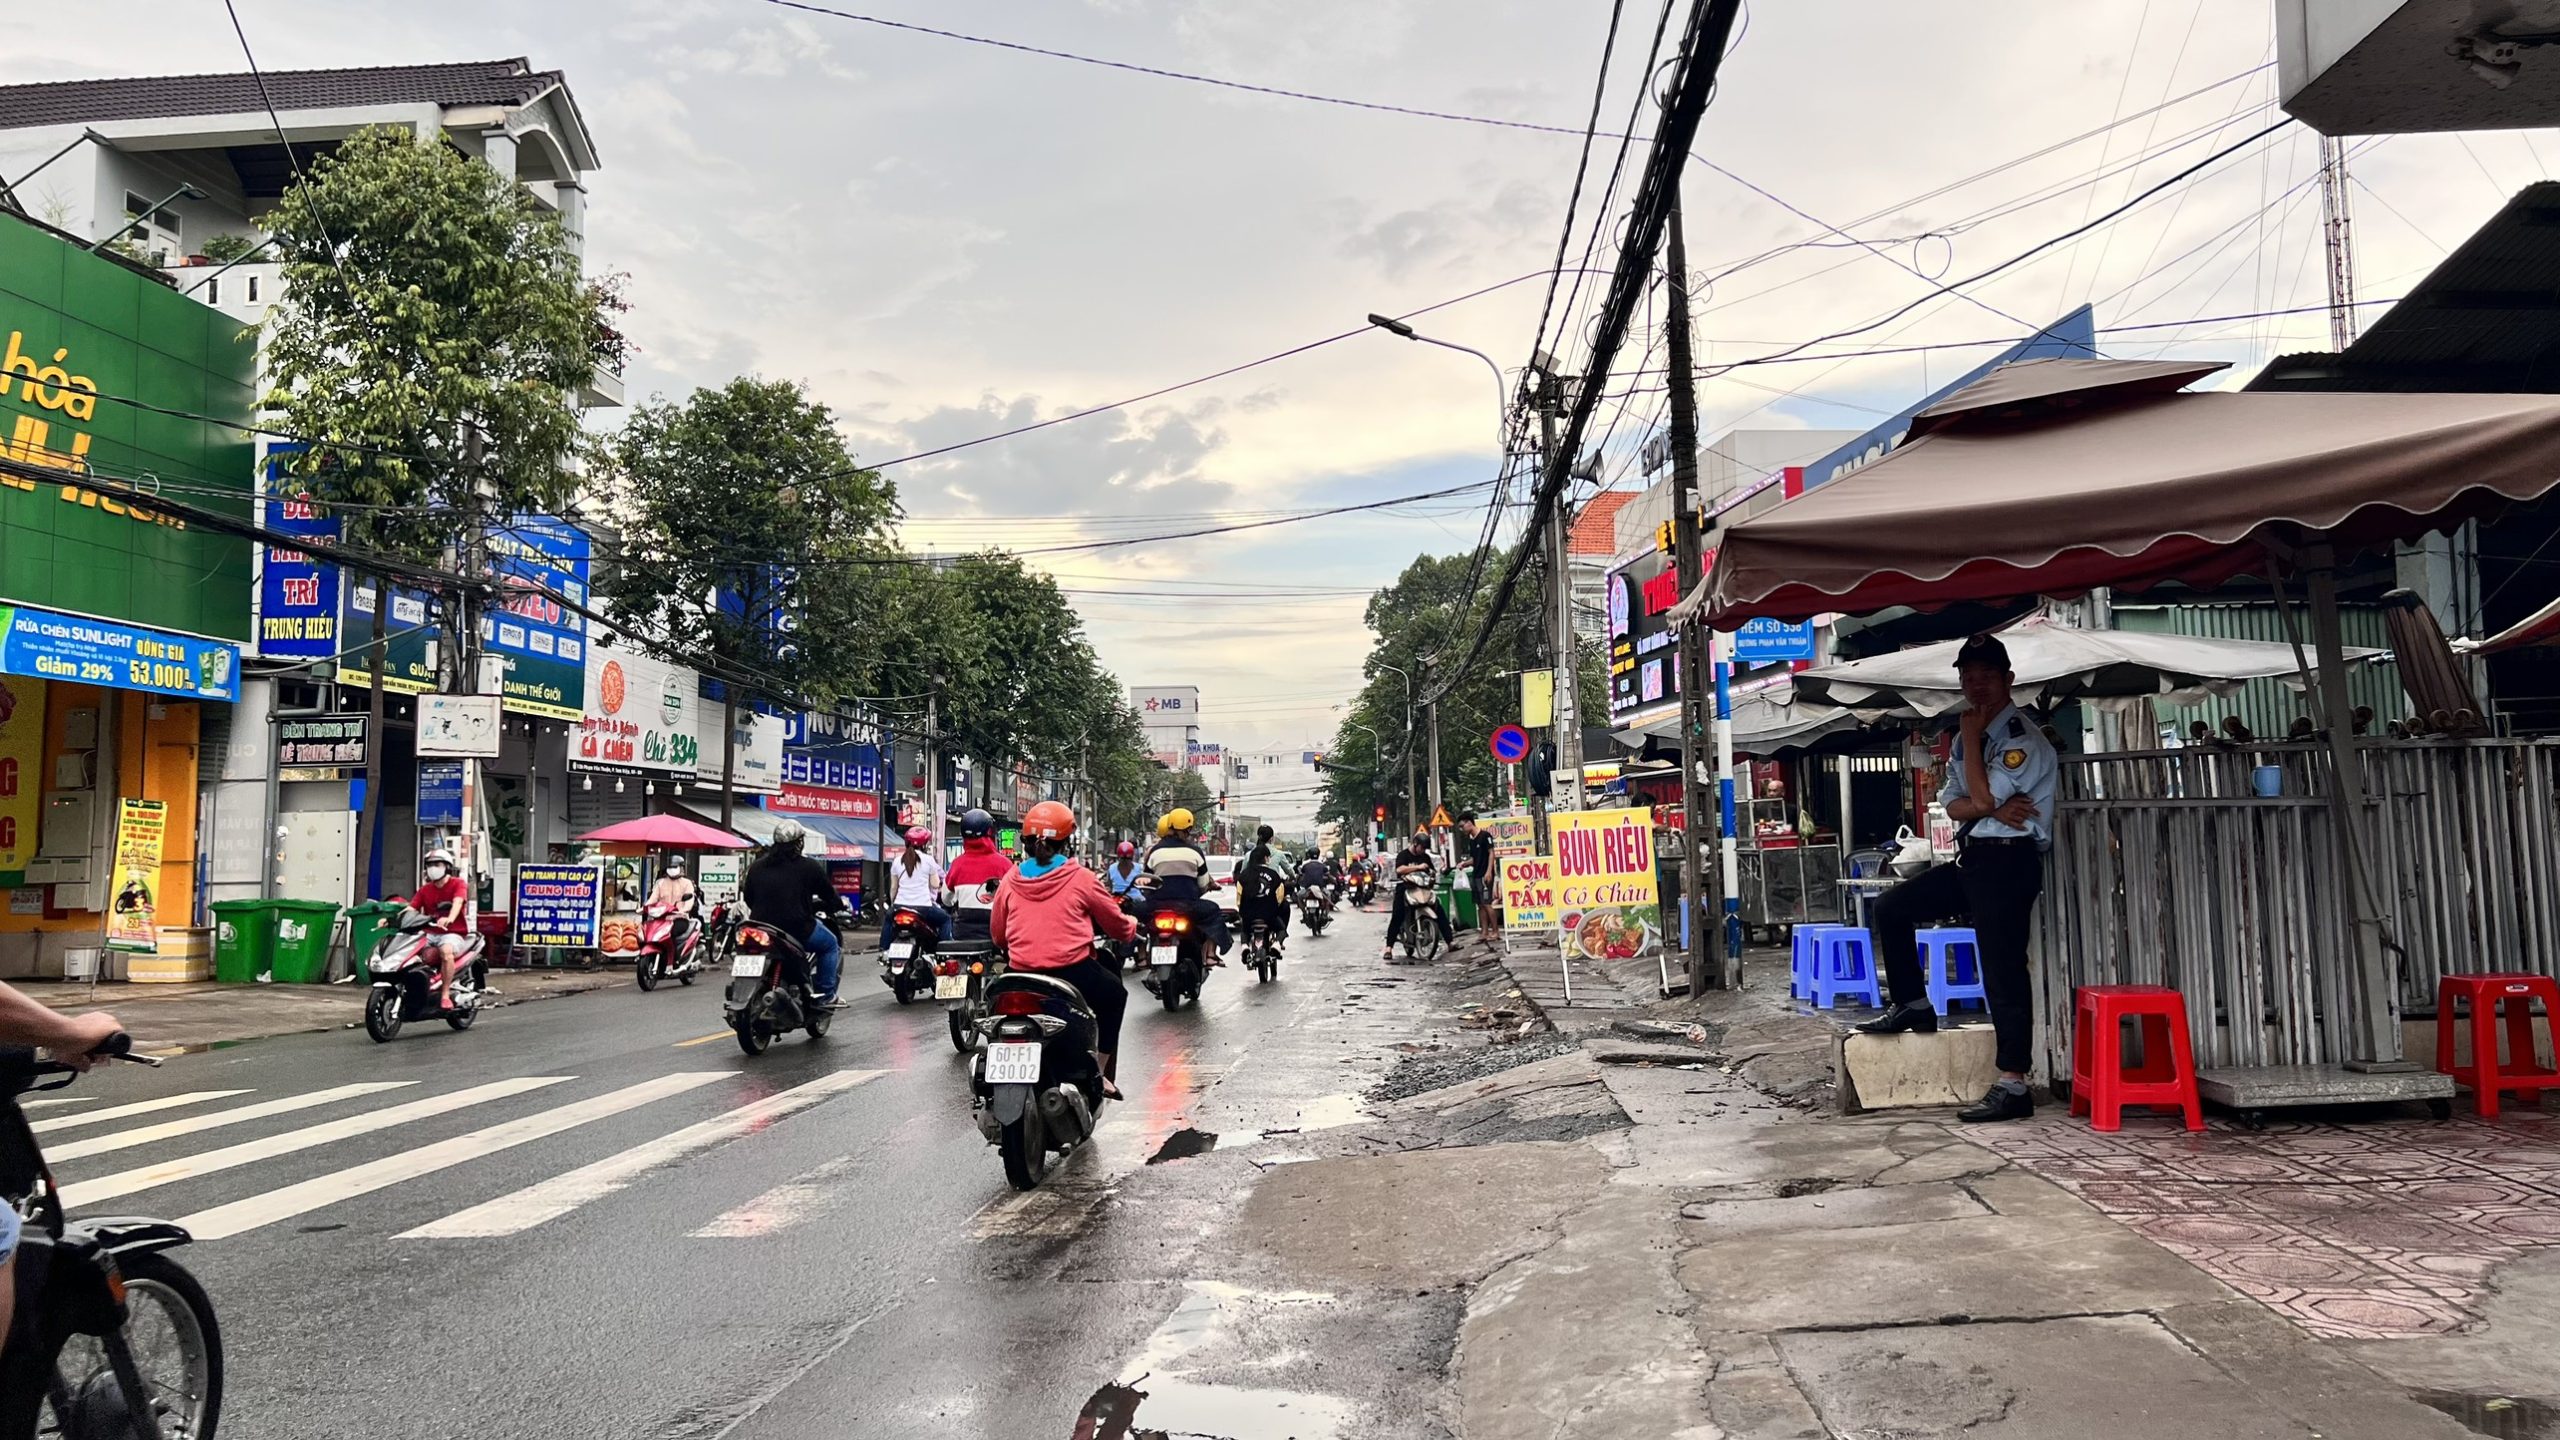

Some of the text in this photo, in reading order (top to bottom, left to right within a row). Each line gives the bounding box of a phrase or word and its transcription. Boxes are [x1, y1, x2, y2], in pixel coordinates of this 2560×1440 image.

[0, 331, 97, 421] hóa
[283, 572, 319, 605] TRÍ
[263, 609, 333, 640] TRUNG HIẾU
[71, 626, 133, 648] SUNLIGHT
[35, 655, 114, 681] Giảm 29%
[504, 680, 562, 701] DANH THẾ GIỚI
[1161, 698, 1181, 709] MB
[282, 719, 364, 738] ĐÈN TRANG TRÍ
[281, 741, 295, 762] LÊ
[296, 743, 335, 762] TRUNG
[643, 729, 667, 762] Chè
[669, 733, 697, 766] 334
[1202, 743, 1220, 752] KHOA
[798, 791, 817, 809] THUỐC
[817, 798, 830, 811] THEO
[1557, 816, 1649, 877] BÚN RIÊU
[1507, 858, 1551, 882] CƠM
[524, 882, 591, 897] TRUNG HIẾU
[1508, 881, 1554, 908] TẤM
[1563, 881, 1648, 905] Cô Châu
[541, 934, 569, 944] TRANG
[989, 1064, 1037, 1080] 290.02
